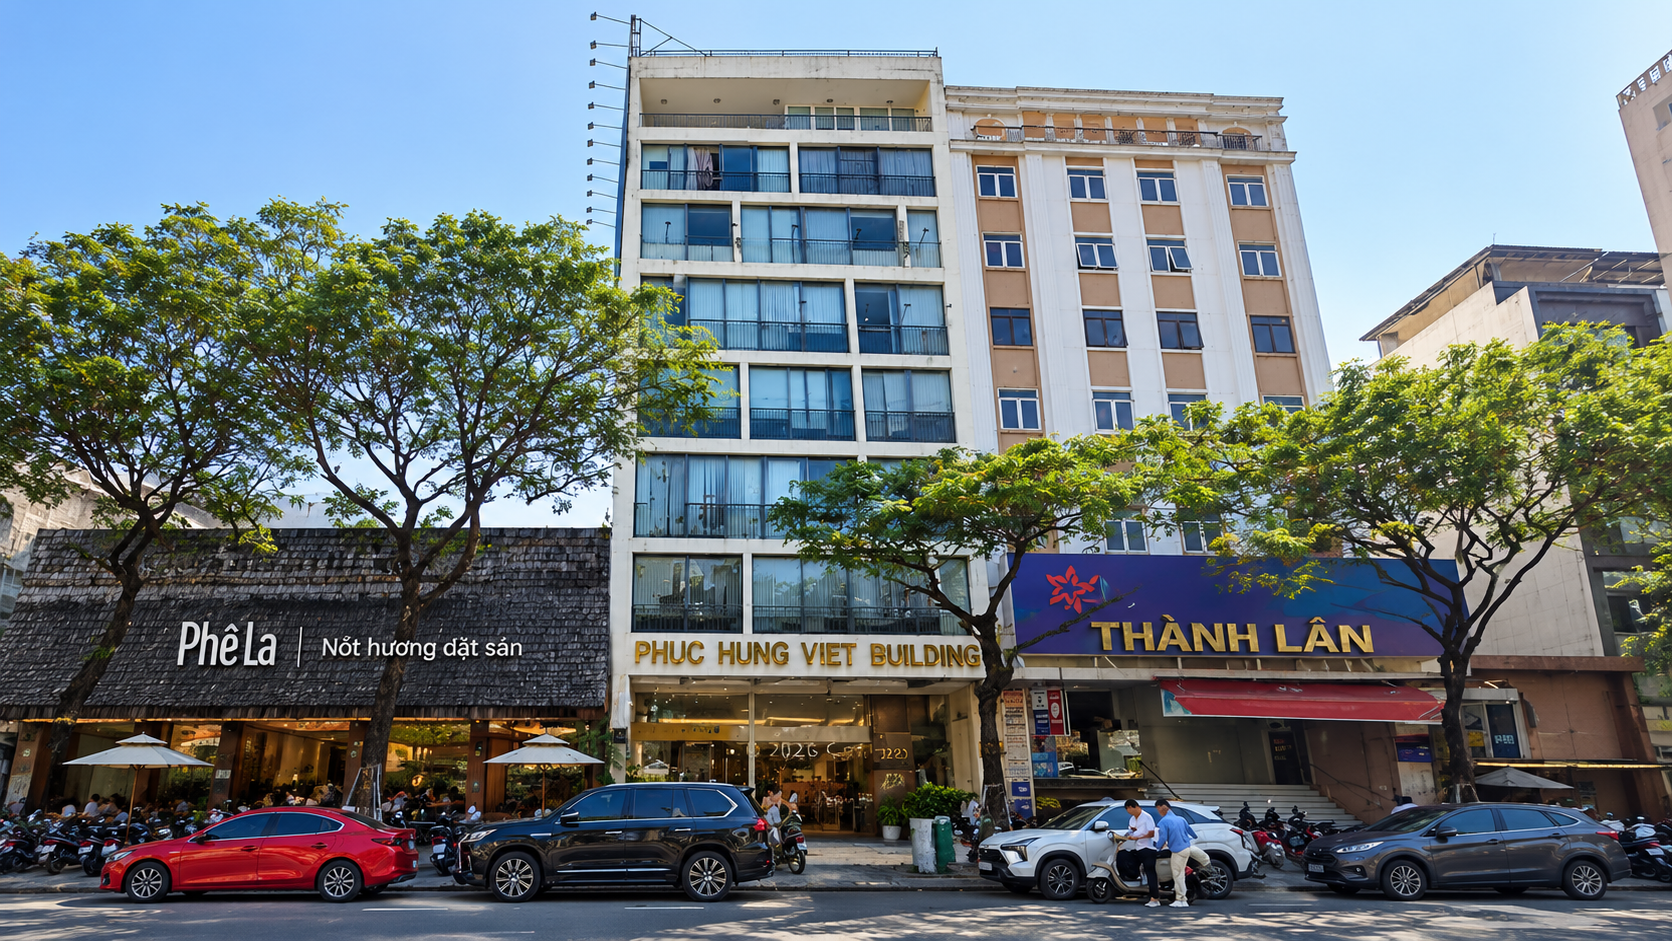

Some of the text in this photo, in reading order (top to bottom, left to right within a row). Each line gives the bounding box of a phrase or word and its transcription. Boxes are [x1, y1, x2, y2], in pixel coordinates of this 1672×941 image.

[176, 621, 240, 667] Phê
[243, 621, 278, 667] La
[367, 636, 437, 662] hương
[484, 636, 523, 657] sản
[1090, 614, 1375, 653] THÀNH LÂN
[634, 640, 981, 668] PHUC HUNG VIET BUILDING
